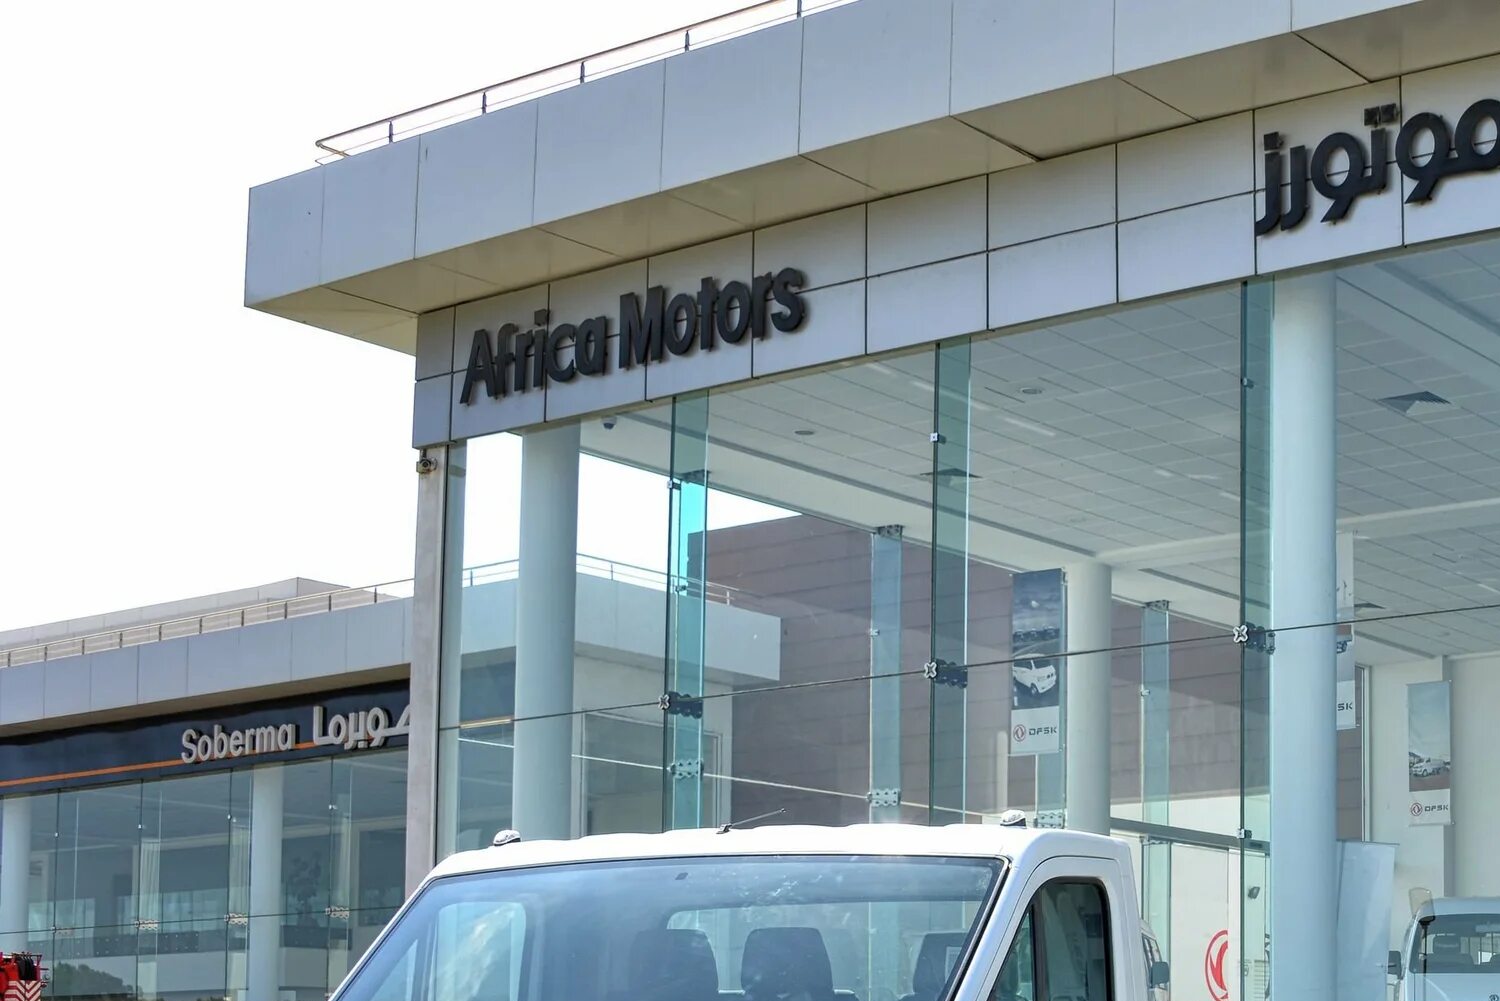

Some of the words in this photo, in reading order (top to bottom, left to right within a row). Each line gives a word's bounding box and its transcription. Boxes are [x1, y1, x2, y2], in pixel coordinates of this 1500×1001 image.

[460, 308, 610, 406] Africa
[618, 266, 811, 371] Motors
[181, 723, 299, 764] Soberma
[1029, 726, 1057, 736] DFSK
[1424, 804, 1449, 812] DFSK
